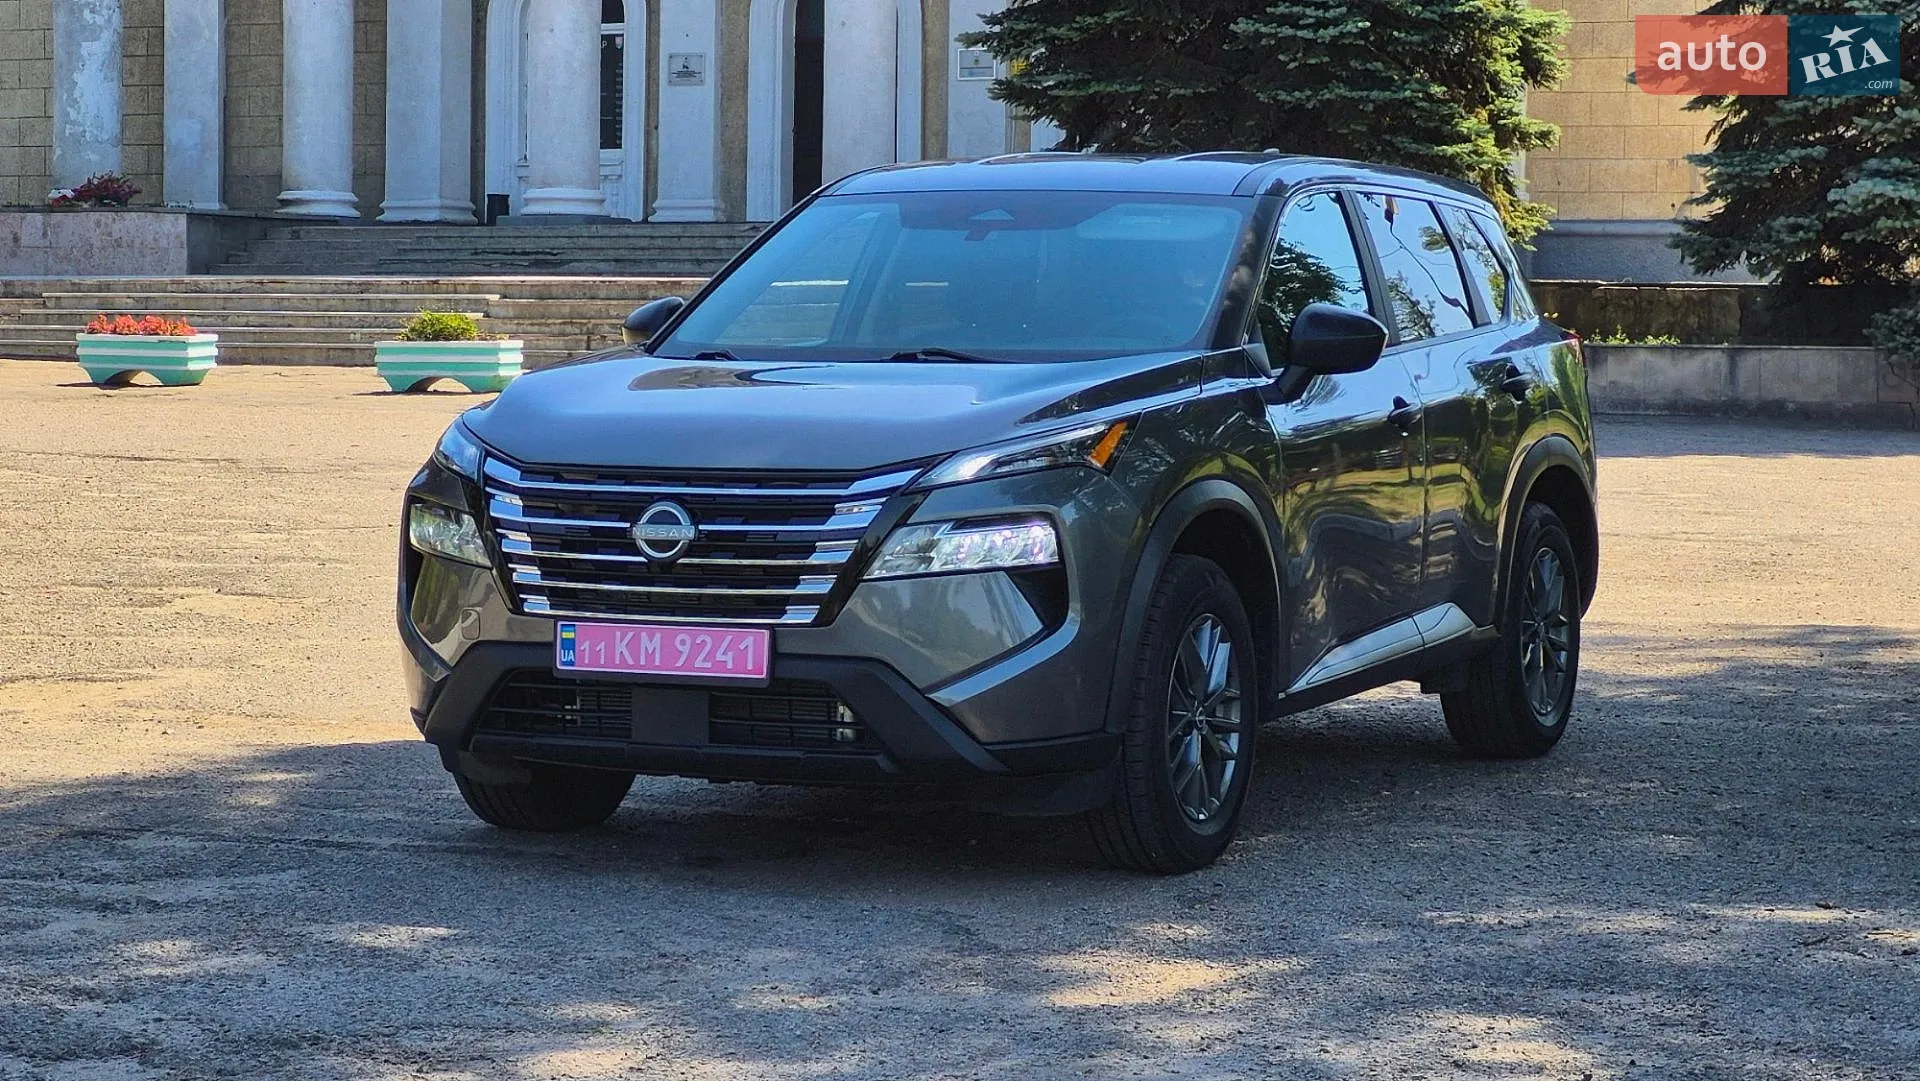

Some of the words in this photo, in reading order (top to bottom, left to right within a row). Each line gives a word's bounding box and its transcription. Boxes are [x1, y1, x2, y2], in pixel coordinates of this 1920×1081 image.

[632, 526, 694, 539] NISSAN
[560, 650, 576, 663] UA
[674, 633, 755, 670] 9241
